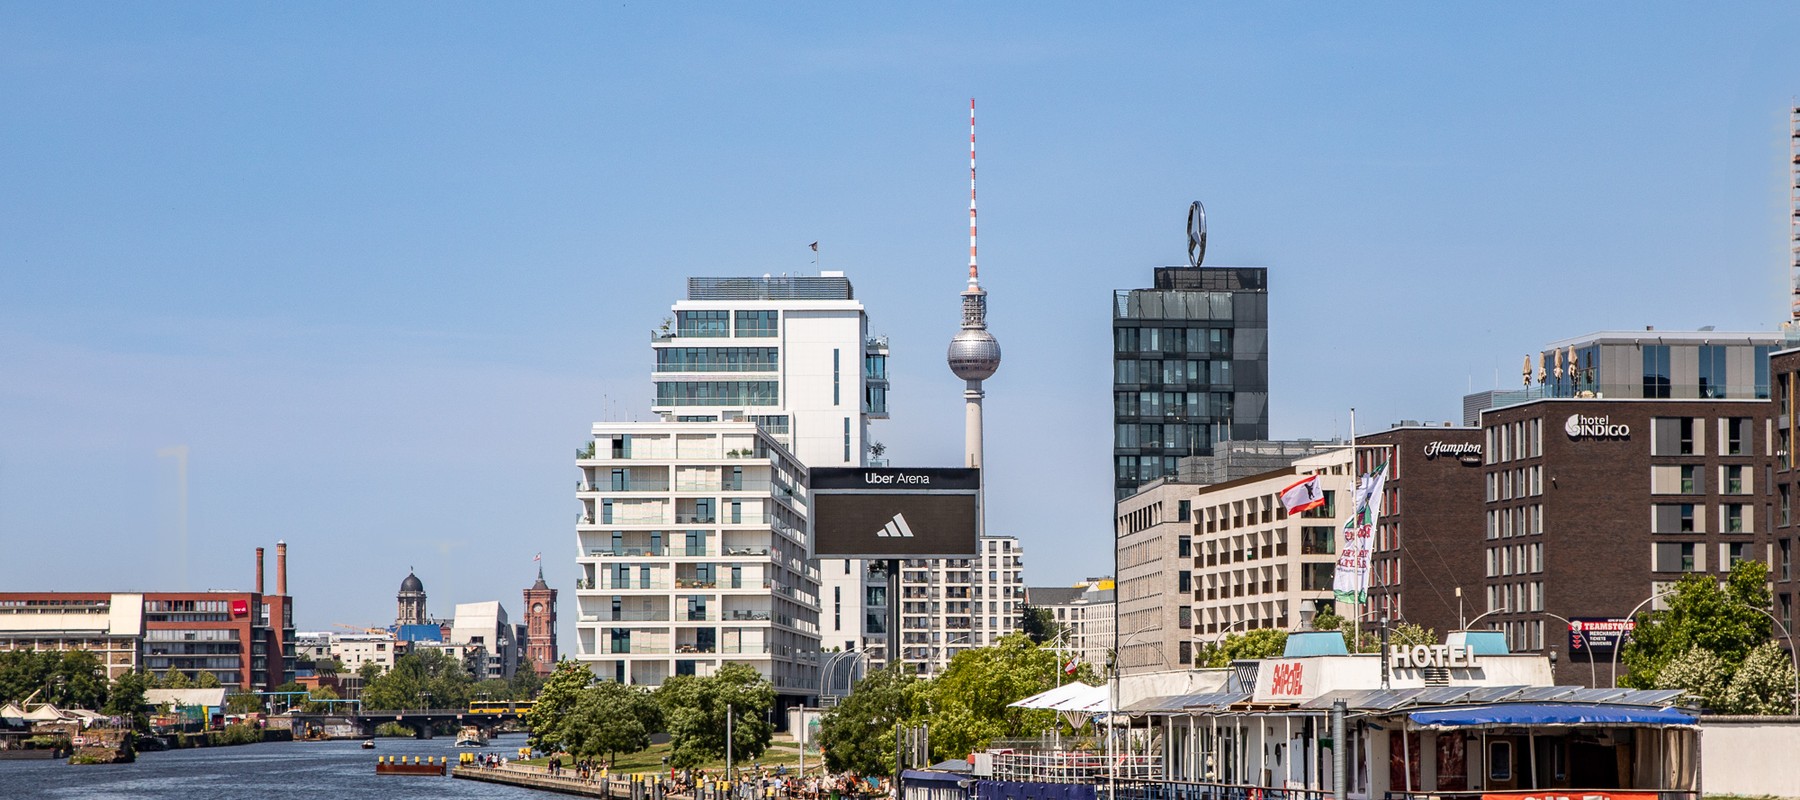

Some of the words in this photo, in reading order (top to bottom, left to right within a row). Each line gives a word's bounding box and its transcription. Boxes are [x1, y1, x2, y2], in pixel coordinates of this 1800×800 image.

[1581, 415, 1609, 425] hotel
[1581, 424, 1630, 436] INDIGO
[1424, 441, 1483, 456] Hampton
[865, 473, 894, 484] Uber
[896, 473, 930, 484] Arena
[1584, 622, 1634, 631] TEAMSTORE
[1390, 644, 1483, 668] HOTEL
